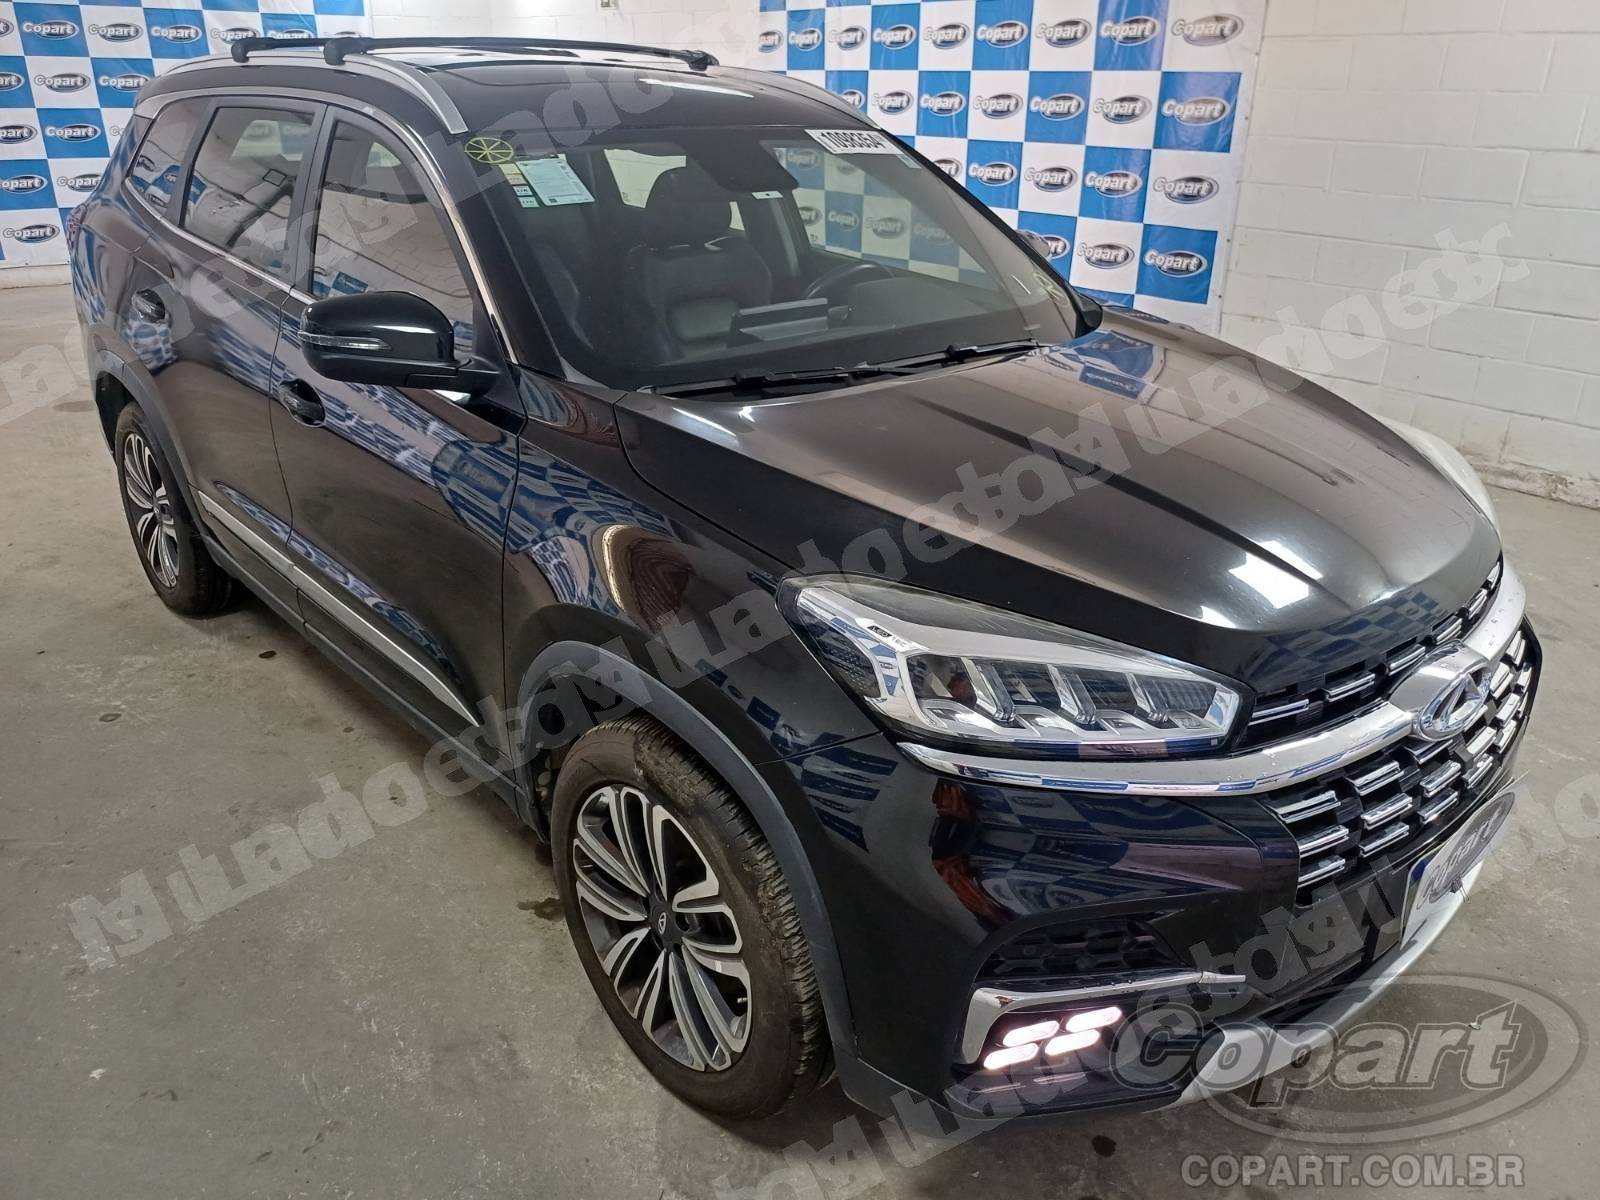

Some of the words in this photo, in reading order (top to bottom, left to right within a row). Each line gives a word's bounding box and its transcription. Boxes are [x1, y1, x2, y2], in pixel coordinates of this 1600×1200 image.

[23, 22, 74, 36] Copart
[88, 24, 137, 38] Copart
[151, 26, 198, 39] Copart
[759, 31, 779, 45] part
[829, 29, 862, 46] Copart
[873, 27, 911, 45] Copart
[923, 25, 966, 45] Copart
[977, 23, 1021, 44] Copart
[1036, 21, 1086, 43] Copart
[1100, 18, 1153, 42] Copart
[1172, 17, 1232, 43] Copart
[788, 31, 818, 46] Copart
[34, 75, 85, 88] Copart
[99, 75, 146, 88] Copart
[871, 92, 908, 110] Copart
[920, 94, 960, 112] Copart
[974, 94, 1018, 114] Copart
[1030, 96, 1079, 117] Copart
[1093, 98, 1143, 119] Copart
[1162, 99, 1223, 120] Copart
[0, 127, 30, 141] part
[45, 126, 95, 140] Copart
[820, 131, 887, 149] 1098354
[968, 161, 1014, 182] Copart
[1023, 166, 1074, 187] Copart
[0, 177, 41, 191] opart
[56, 175, 100, 189] Copar
[1084, 171, 1139, 193] Copart
[1153, 176, 1211, 200] Copart
[3, 226, 52, 241] Copart
[1077, 242, 1127, 264] Copart
[1144, 249, 1200, 273] Copart
